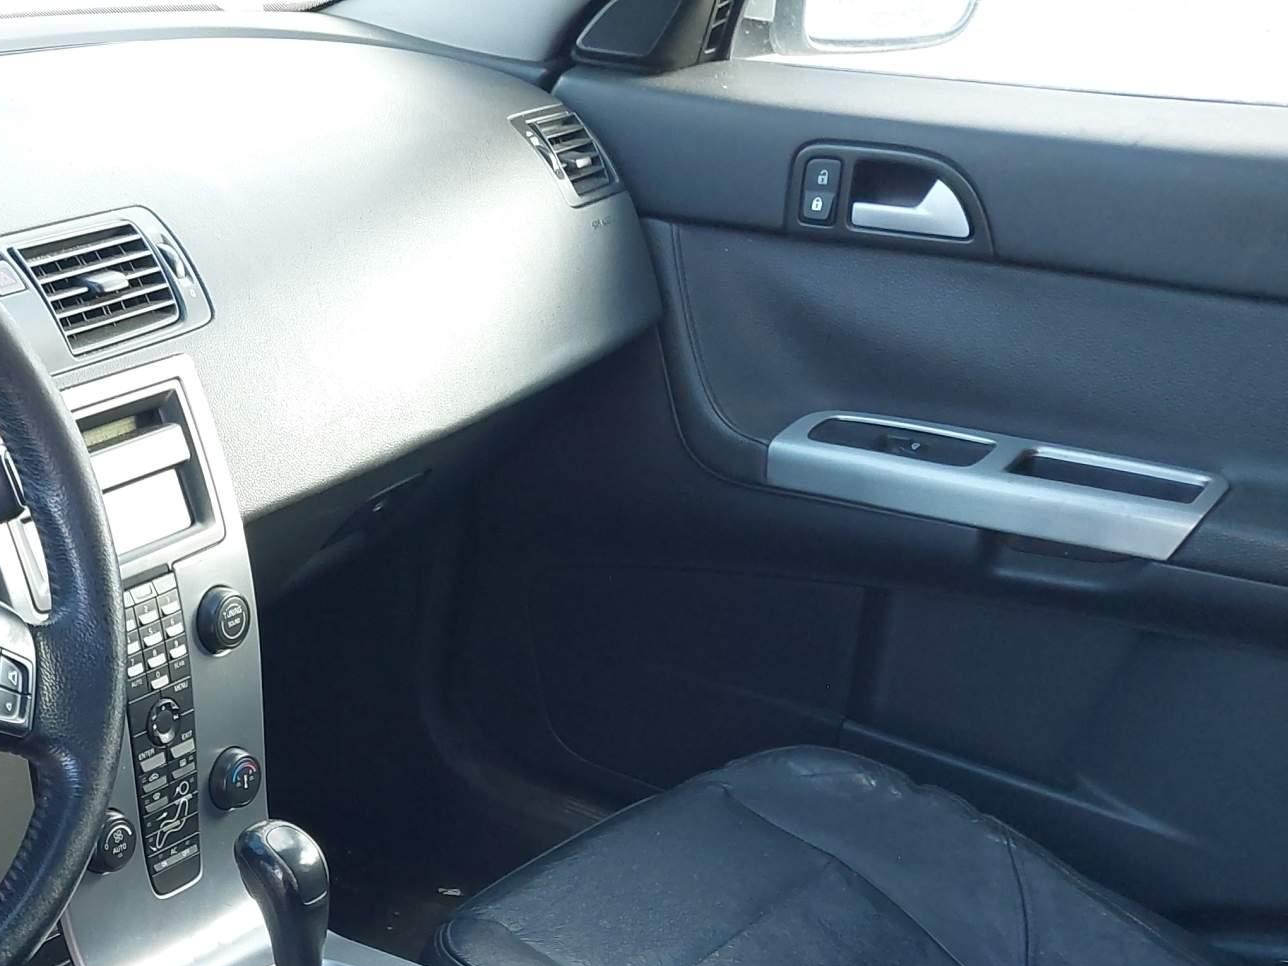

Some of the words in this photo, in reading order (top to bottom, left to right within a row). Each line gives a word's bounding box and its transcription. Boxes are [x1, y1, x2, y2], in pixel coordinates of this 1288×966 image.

[173, 680, 188, 692] MENU
[181, 730, 193, 741] EXIT
[138, 748, 155, 761] ENTER
[112, 842, 127, 855] AUTO
